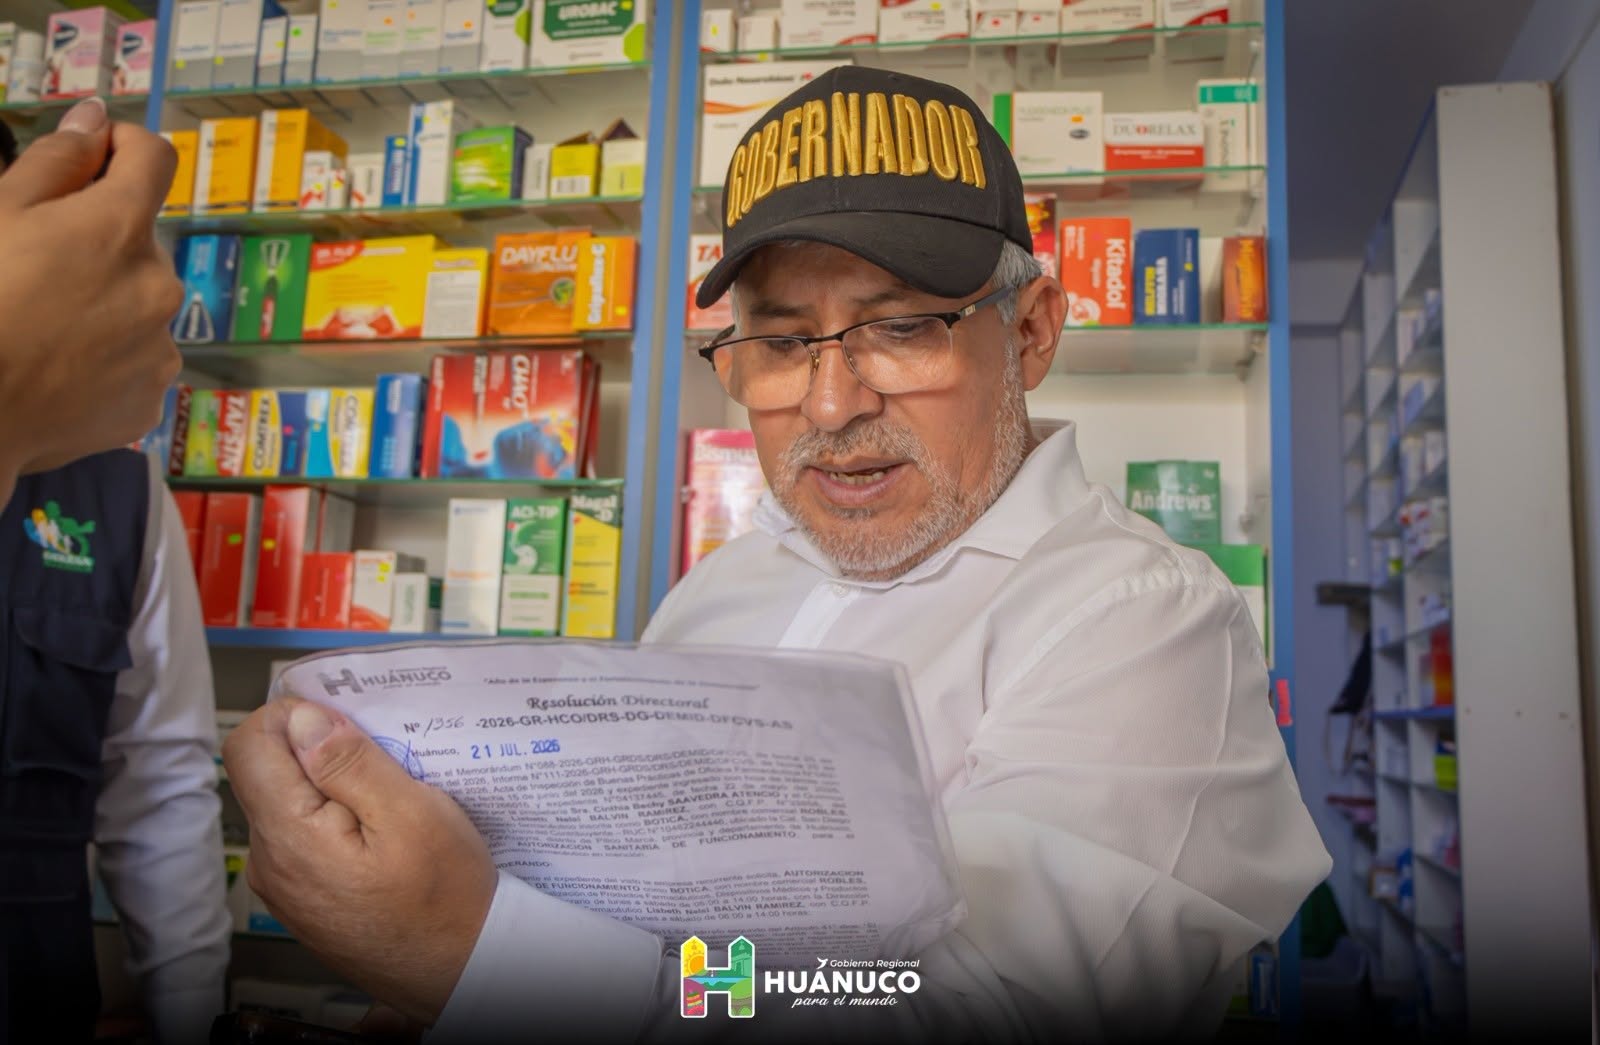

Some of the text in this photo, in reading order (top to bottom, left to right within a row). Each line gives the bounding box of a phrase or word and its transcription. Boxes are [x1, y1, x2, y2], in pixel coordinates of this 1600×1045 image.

[727, 91, 987, 229] GOBERNADOR
[501, 245, 578, 266] DAYFLU
[1106, 238, 1128, 310] Kitadol
[1131, 489, 1213, 512] Andrews
[511, 505, 560, 519] ACI-TIP
[527, 694, 710, 711] Resolución Directoral
[471, 738, 561, 760] 21 JUL. 2026
[668, 791, 729, 806] SAAVEDRA
[732, 790, 780, 799] ATENCIO
[589, 812, 629, 822] BALVIN
[517, 841, 592, 850] AUTORIZACION
[604, 843, 660, 851] SANITARIA
[671, 840, 687, 848] DE
[698, 831, 797, 845] FUNCIONAMIENTO
[495, 860, 552, 869] IDERANDO:
[784, 869, 864, 877] AUTORIZACION
[551, 881, 641, 892] FUNCIONAMIENTO
[714, 903, 752, 913] BALVIN
